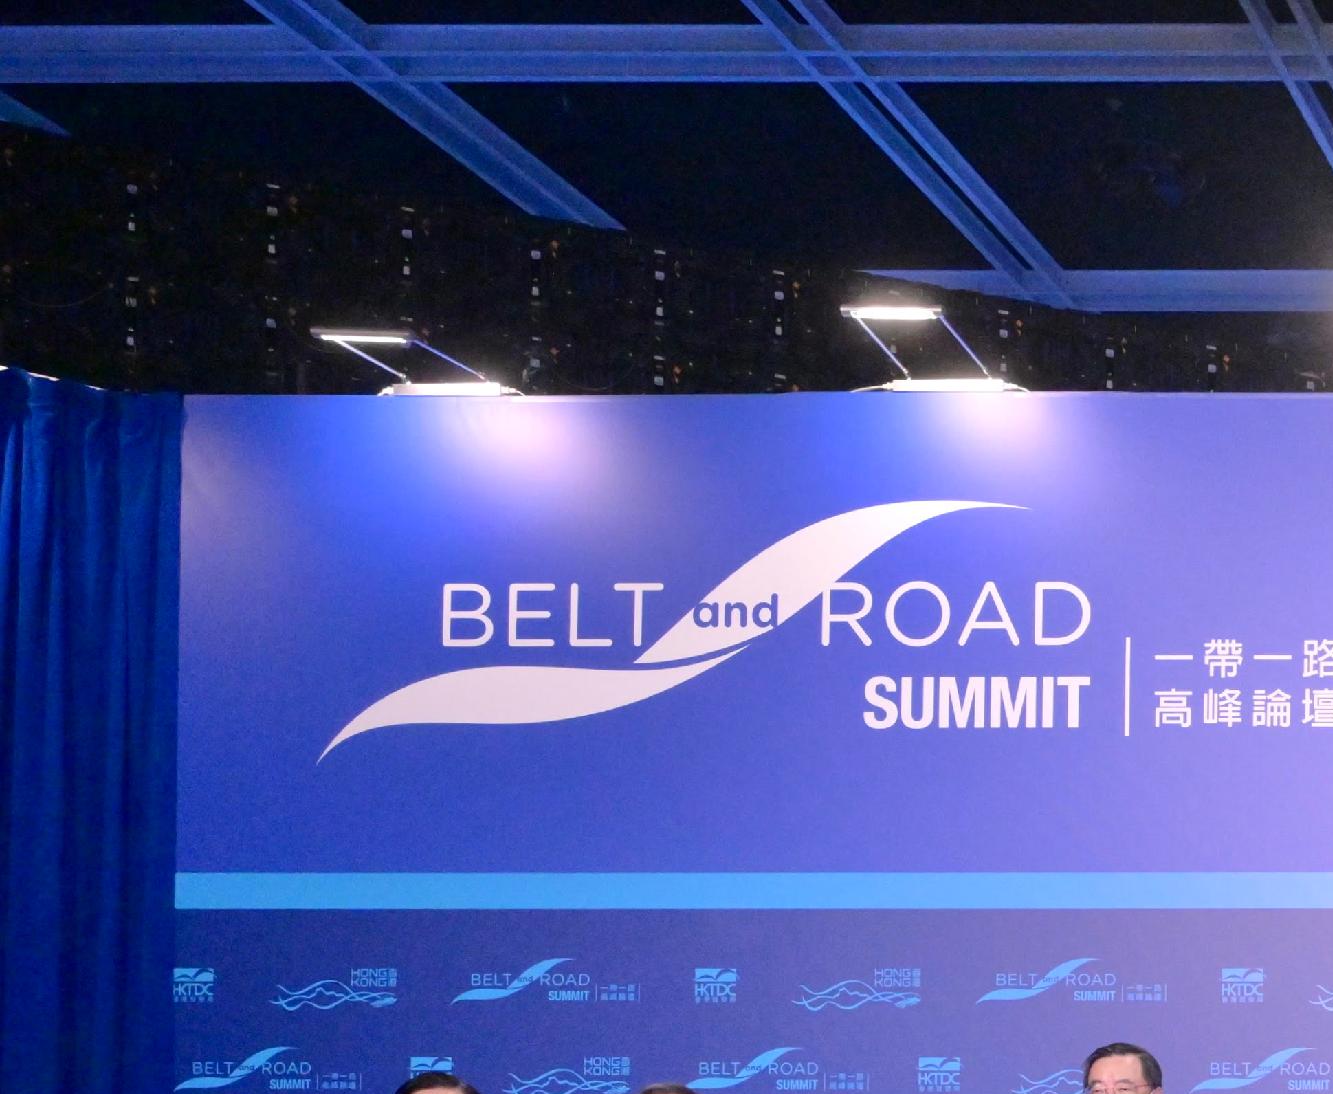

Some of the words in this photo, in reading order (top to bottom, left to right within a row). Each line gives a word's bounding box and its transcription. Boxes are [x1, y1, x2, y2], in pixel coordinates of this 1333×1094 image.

[441, 582, 664, 647] BELT
[692, 592, 779, 629] and
[821, 580, 1092, 648] ROAD
[862, 675, 1091, 729] SUMMIT
[471, 974, 511, 986] BELT
[539, 974, 590, 986] ROAD
[996, 974, 1036, 986] BELT
[1066, 974, 1116, 986] ROAD
[548, 991, 589, 1001] SUMMIT
[1073, 991, 1115, 1001] SUMMIT
[192, 1063, 233, 1075] BELT
[262, 1063, 311, 1075] ROAD
[699, 1063, 739, 1075] BELT
[769, 1063, 818, 1075] ROAD
[1210, 1063, 1251, 1075] BELT
[1280, 1063, 1330, 1075] ROAD
[270, 1079, 311, 1089] SUMMIT
[776, 1080, 818, 1090] SUMMIT
[1288, 1080, 1330, 1090] SUMMIT
